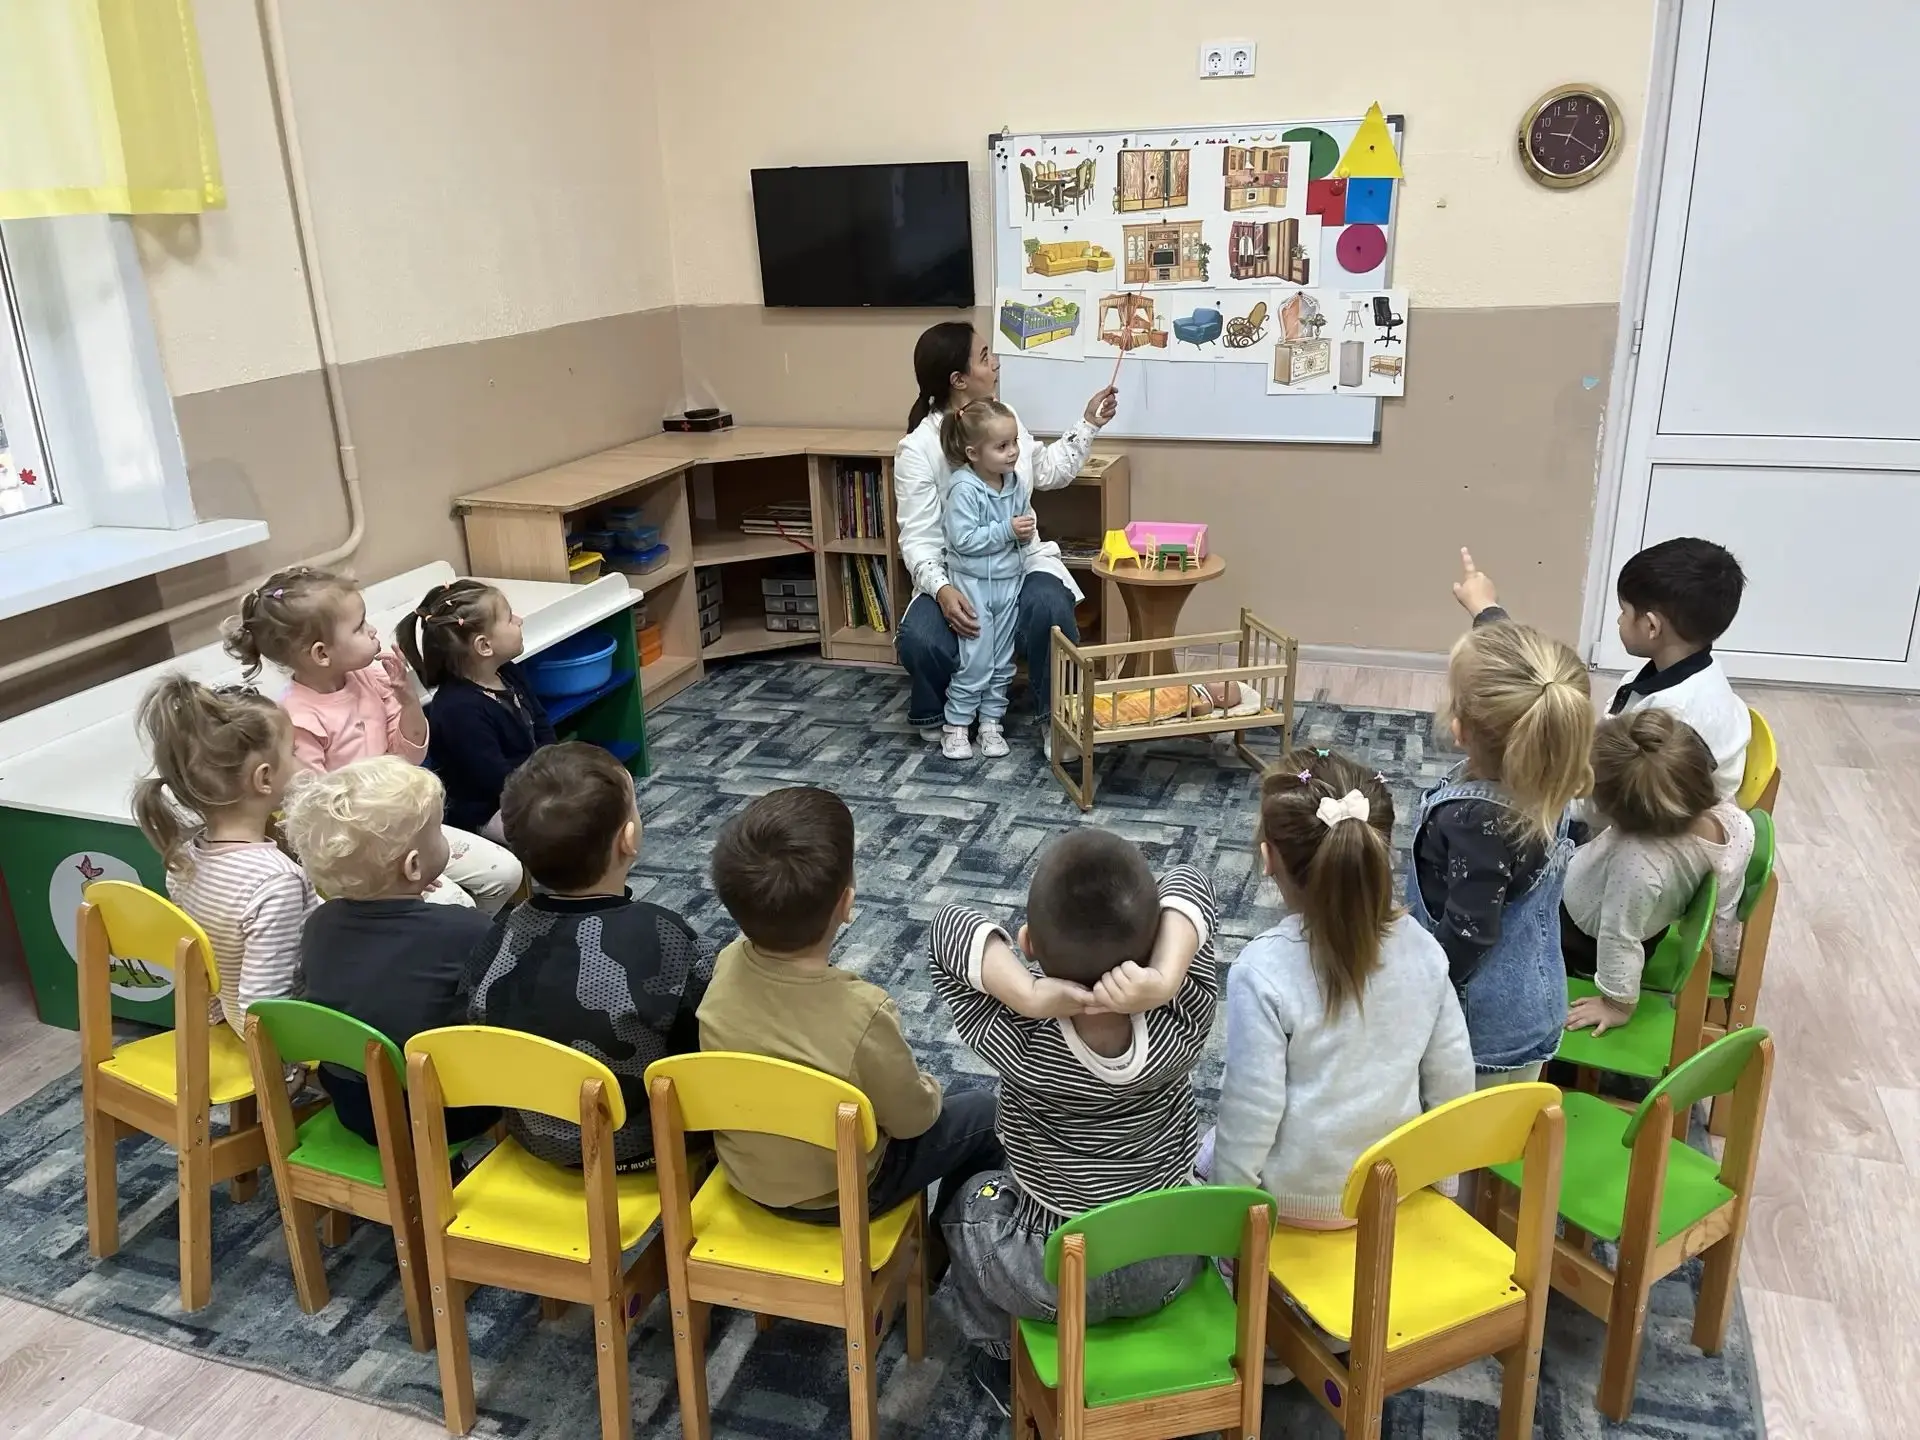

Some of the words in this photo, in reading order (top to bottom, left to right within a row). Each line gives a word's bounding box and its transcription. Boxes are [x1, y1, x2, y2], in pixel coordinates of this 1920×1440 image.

[1553, 106, 1561, 116] 11
[1567, 101, 1577, 111] 12
[1586, 104, 1590, 114] 1
[1541, 118, 1551, 128] 10
[1595, 115, 1602, 124] 2
[1536, 132, 1542, 142] 9
[1598, 129, 1604, 139] 3
[1050, 146, 1057, 156] 1
[1539, 147, 1545, 156] 8
[1549, 158, 1556, 167] 7
[1563, 160, 1570, 170] 6
[1579, 155, 1586, 165] 5
